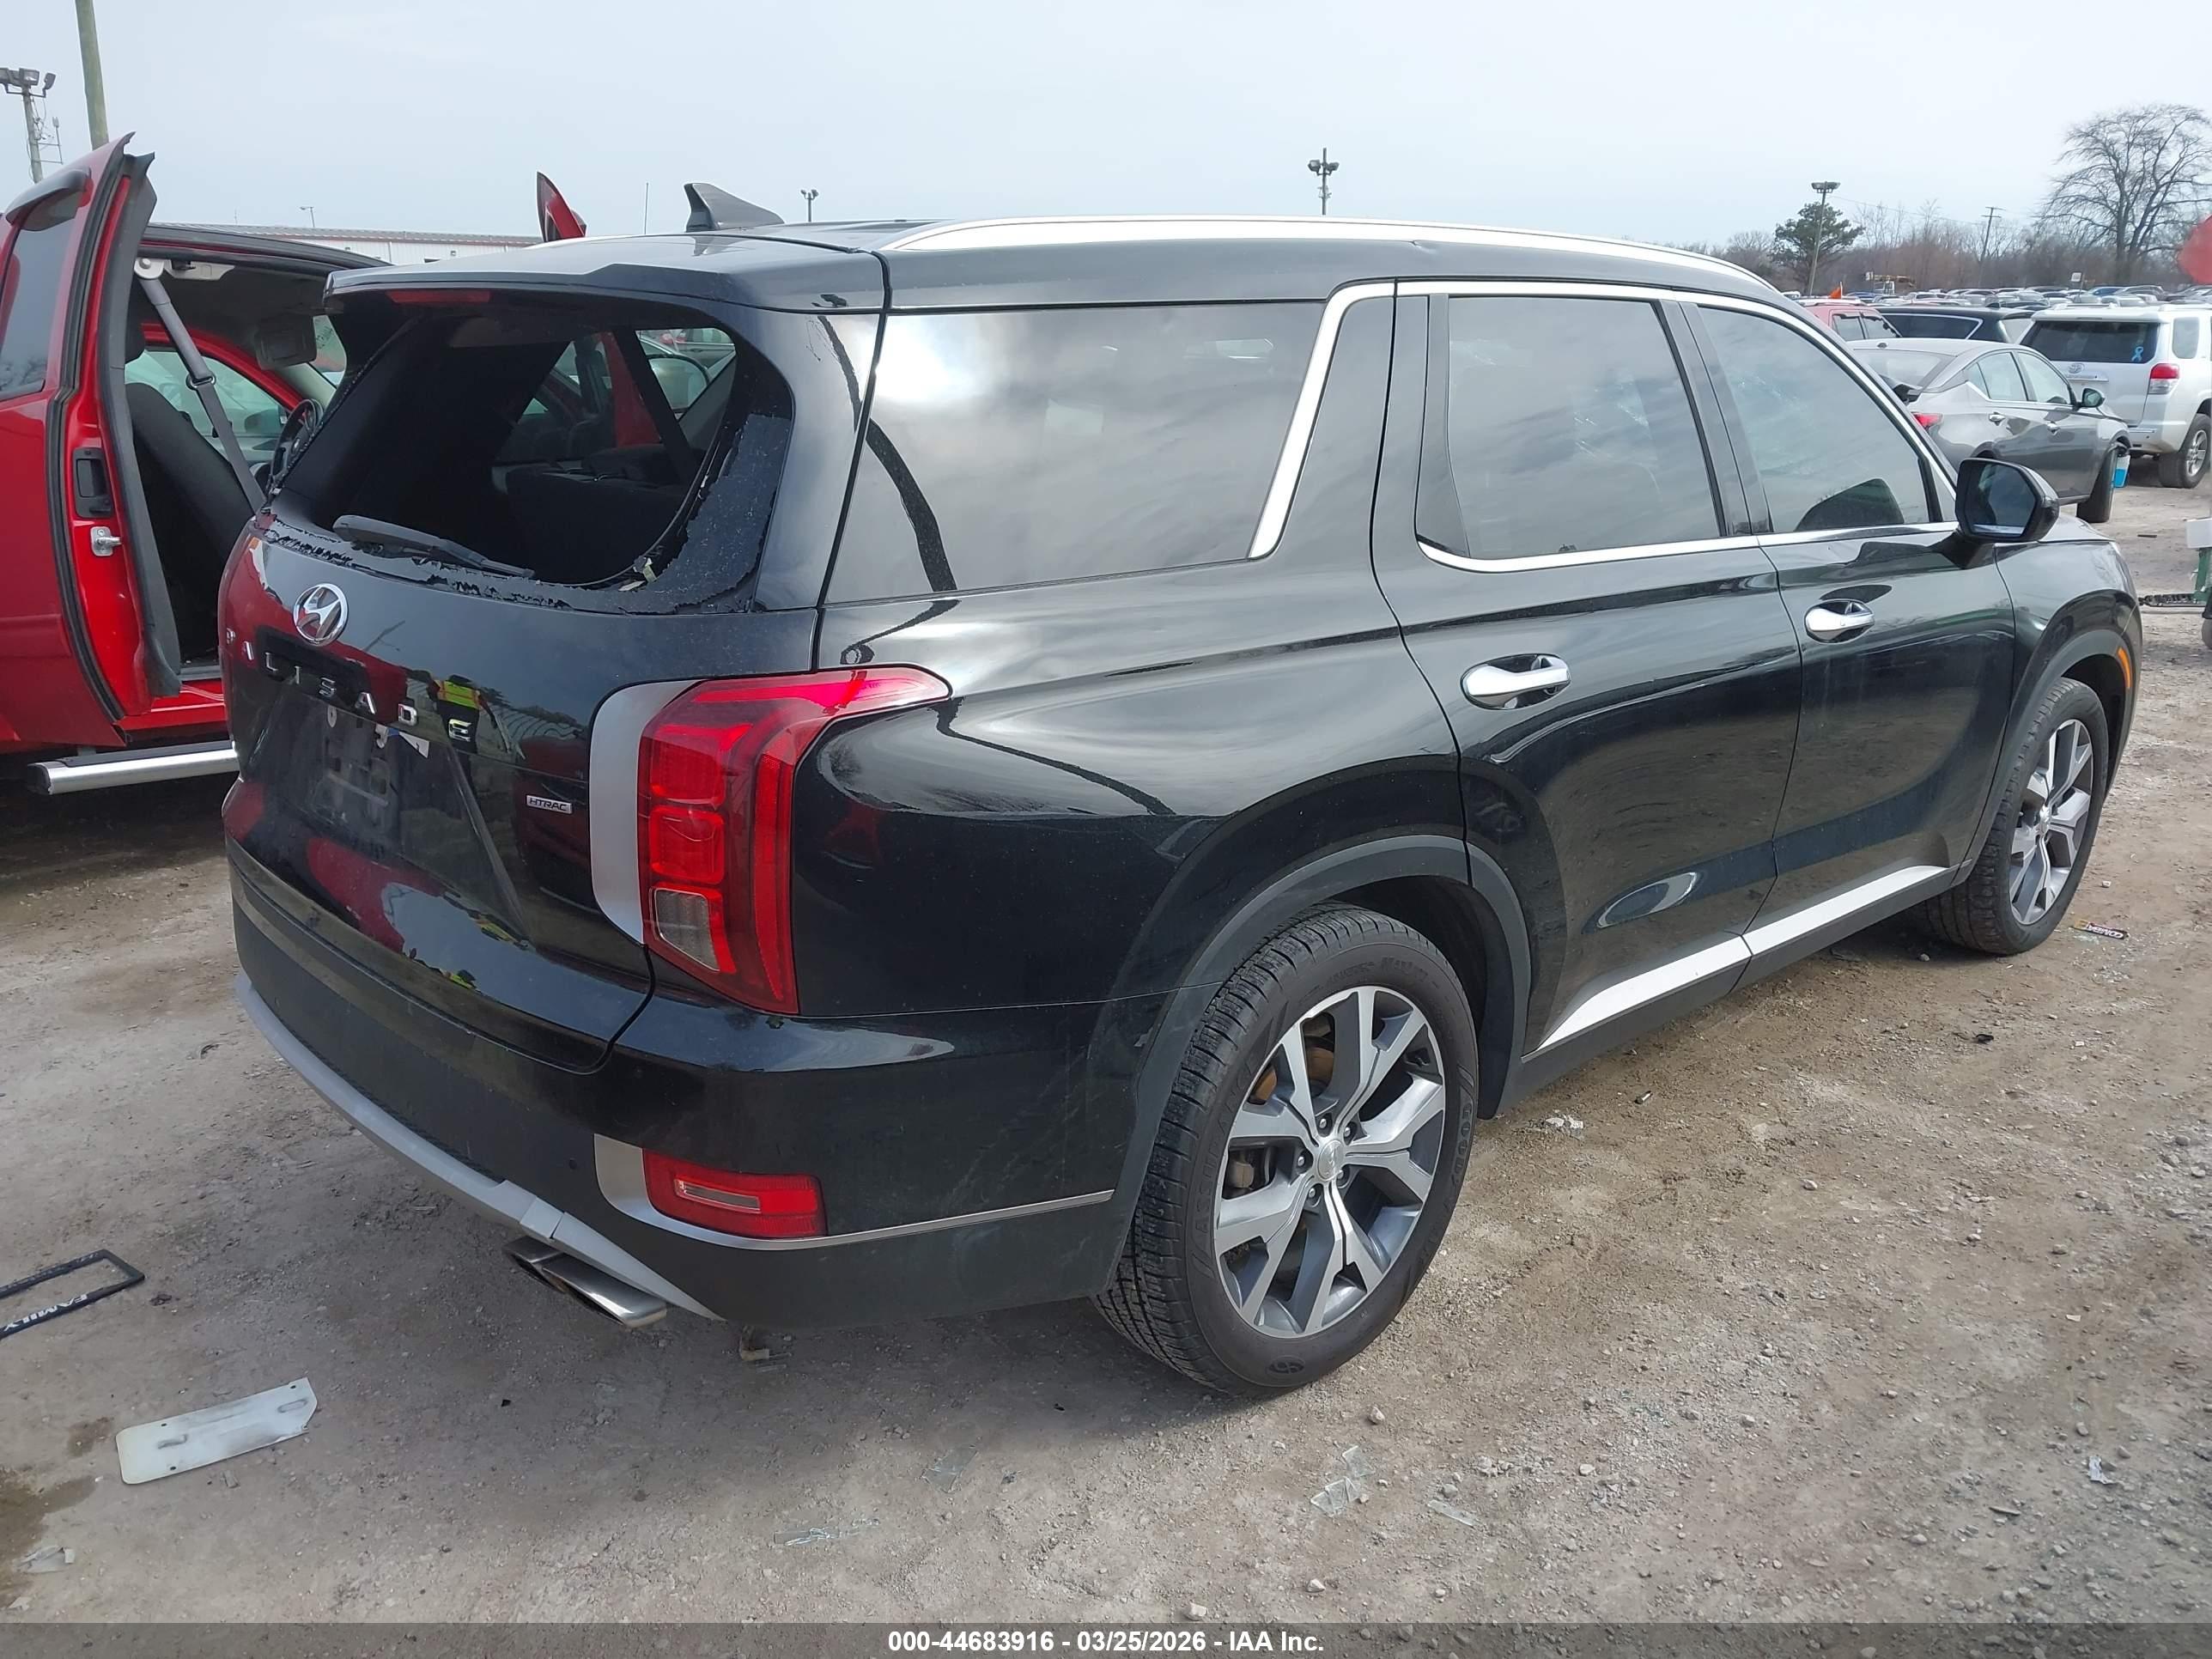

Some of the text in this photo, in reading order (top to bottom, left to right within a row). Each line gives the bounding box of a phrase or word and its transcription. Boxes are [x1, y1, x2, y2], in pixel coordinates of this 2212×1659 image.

[226, 628, 471, 743] PALISADE
[529, 798, 567, 811] HTRAC
[3, 1293, 88, 1331] FAMILY
